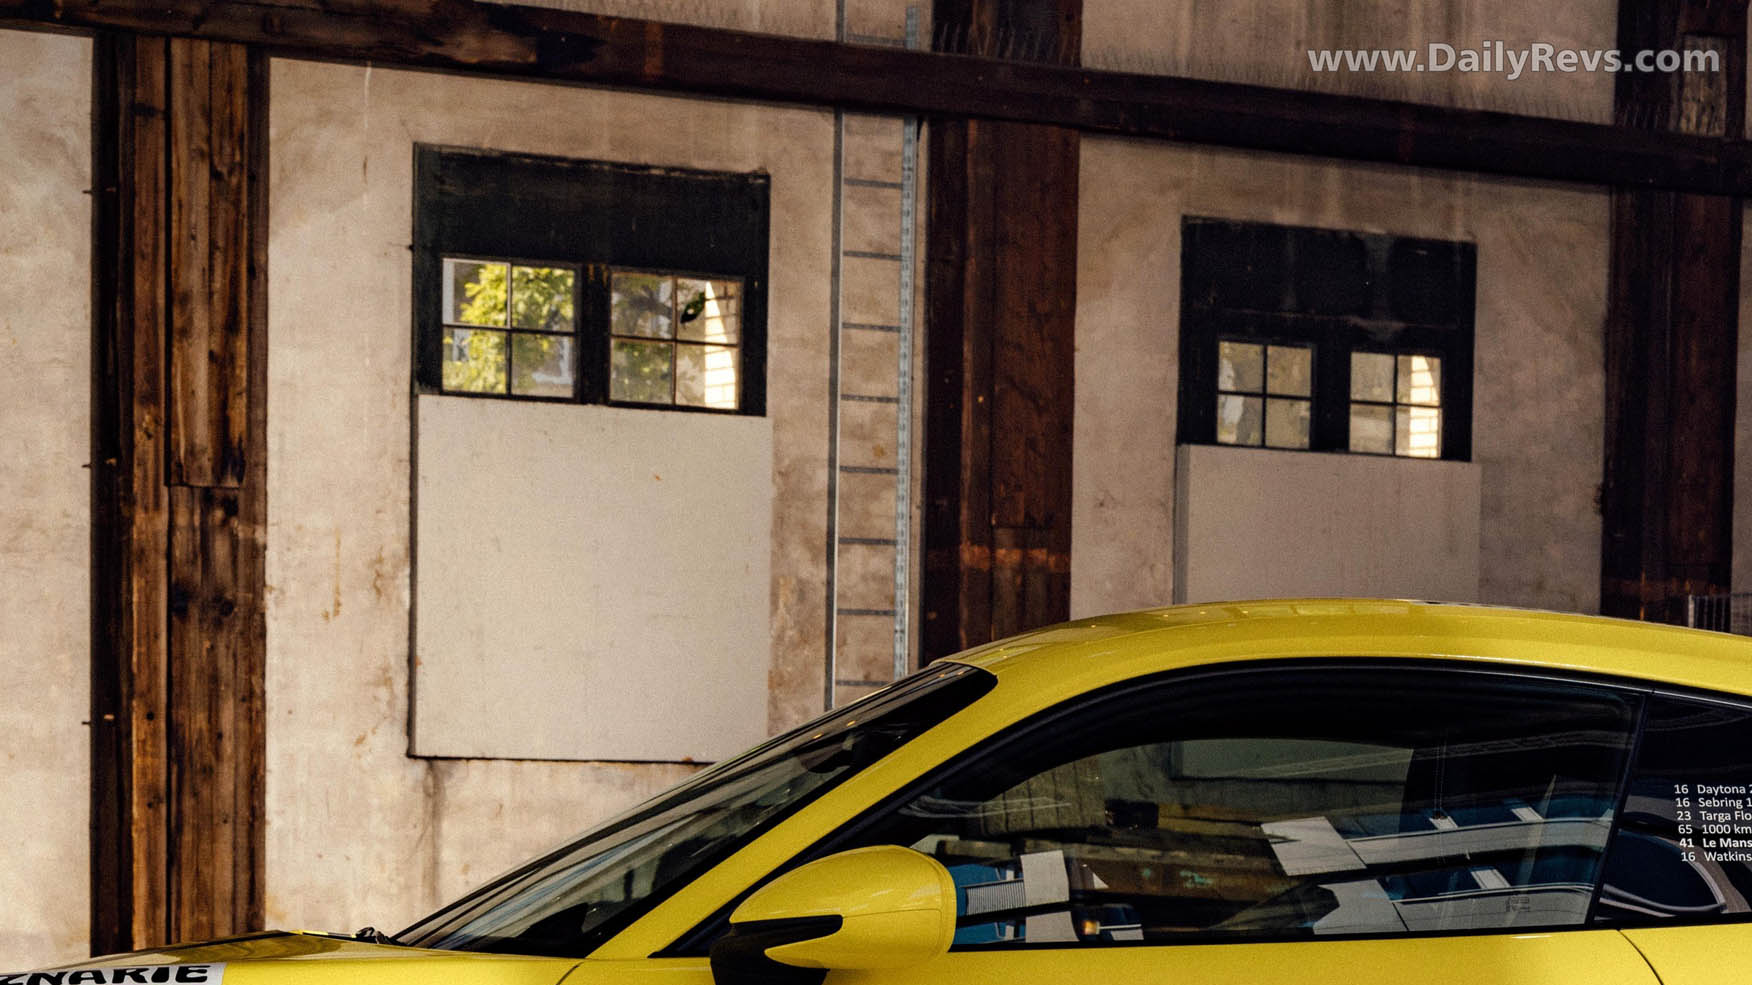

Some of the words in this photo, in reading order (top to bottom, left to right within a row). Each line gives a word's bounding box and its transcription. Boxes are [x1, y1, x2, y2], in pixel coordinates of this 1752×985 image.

[1673, 784, 1689, 795] 16
[1696, 784, 1746, 797] Daytona
[1675, 797, 1691, 808] 16
[1698, 797, 1744, 810] Sebring
[1676, 811, 1692, 821] 23
[1699, 811, 1732, 823] Targa
[1678, 824, 1693, 834] 65
[1702, 824, 1731, 834] 1000
[1679, 838, 1695, 848] 41
[1702, 838, 1717, 848] Le
[1719, 838, 1752, 848] Mans
[1680, 851, 1696, 862] 16
[1704, 851, 1752, 862] Watkins
